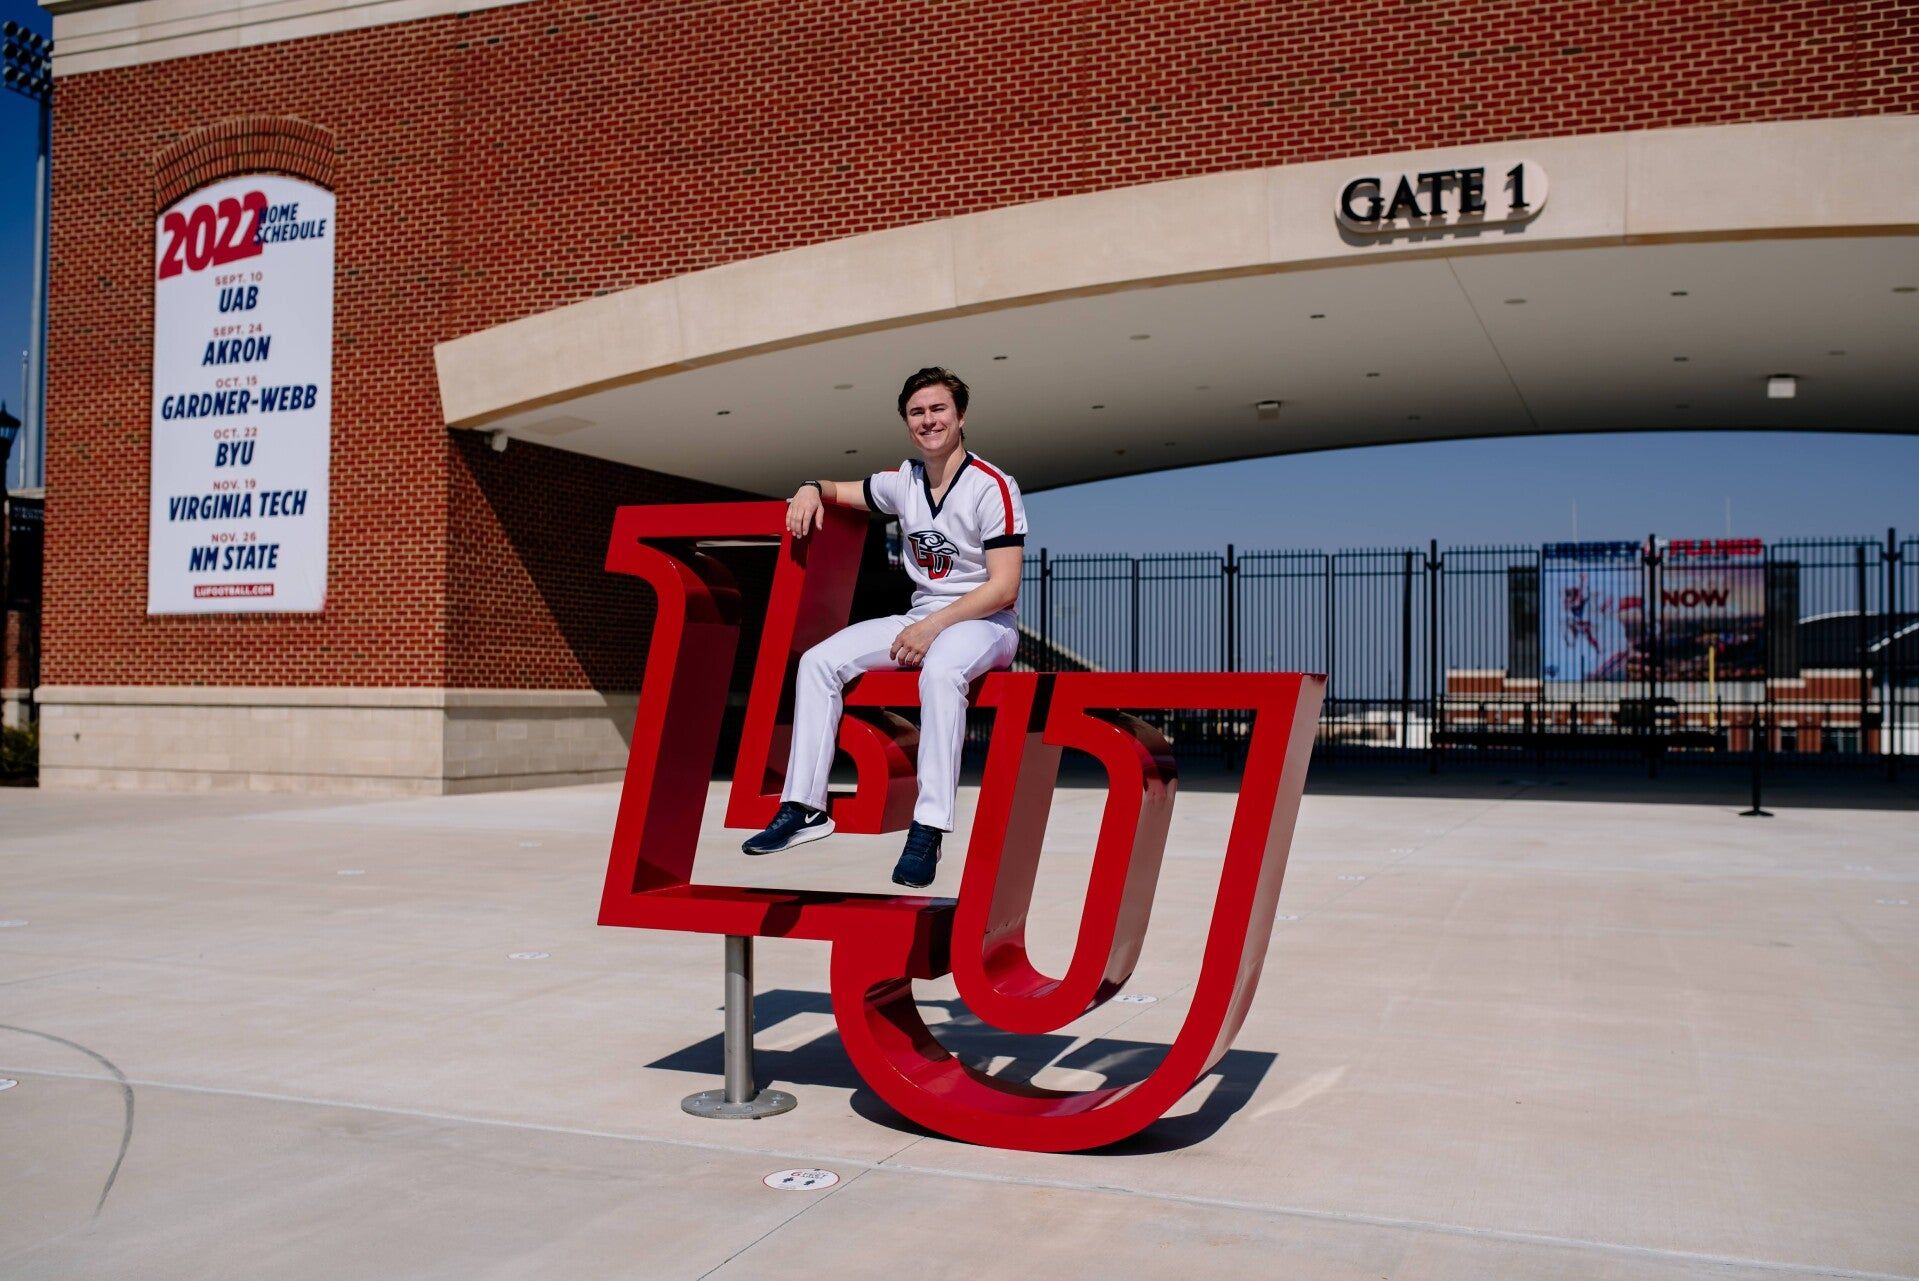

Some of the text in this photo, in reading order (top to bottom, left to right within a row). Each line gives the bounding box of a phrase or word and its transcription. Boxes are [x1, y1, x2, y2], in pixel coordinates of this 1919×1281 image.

[1341, 162, 1530, 222] GATE 1
[259, 202, 299, 224] HOME
[158, 190, 268, 280] 2022
[254, 219, 327, 244] SCHEDULE
[215, 271, 263, 285] SEPT. 10
[218, 286, 259, 313] UAB
[213, 323, 263, 336] SEPT. 24
[201, 336, 271, 367] AKRON
[215, 377, 242, 388] OCT.
[161, 384, 318, 421] GARDNER-WEBB
[213, 426, 258, 440] OCT. 22
[215, 439, 255, 467] BYU
[213, 478, 257, 490] NOV. 19
[168, 489, 307, 522] VIRGINIA TECH
[211, 532, 238, 543] NOV.
[189, 543, 279, 572] NM STATE
[1661, 588, 1729, 608] NOW
